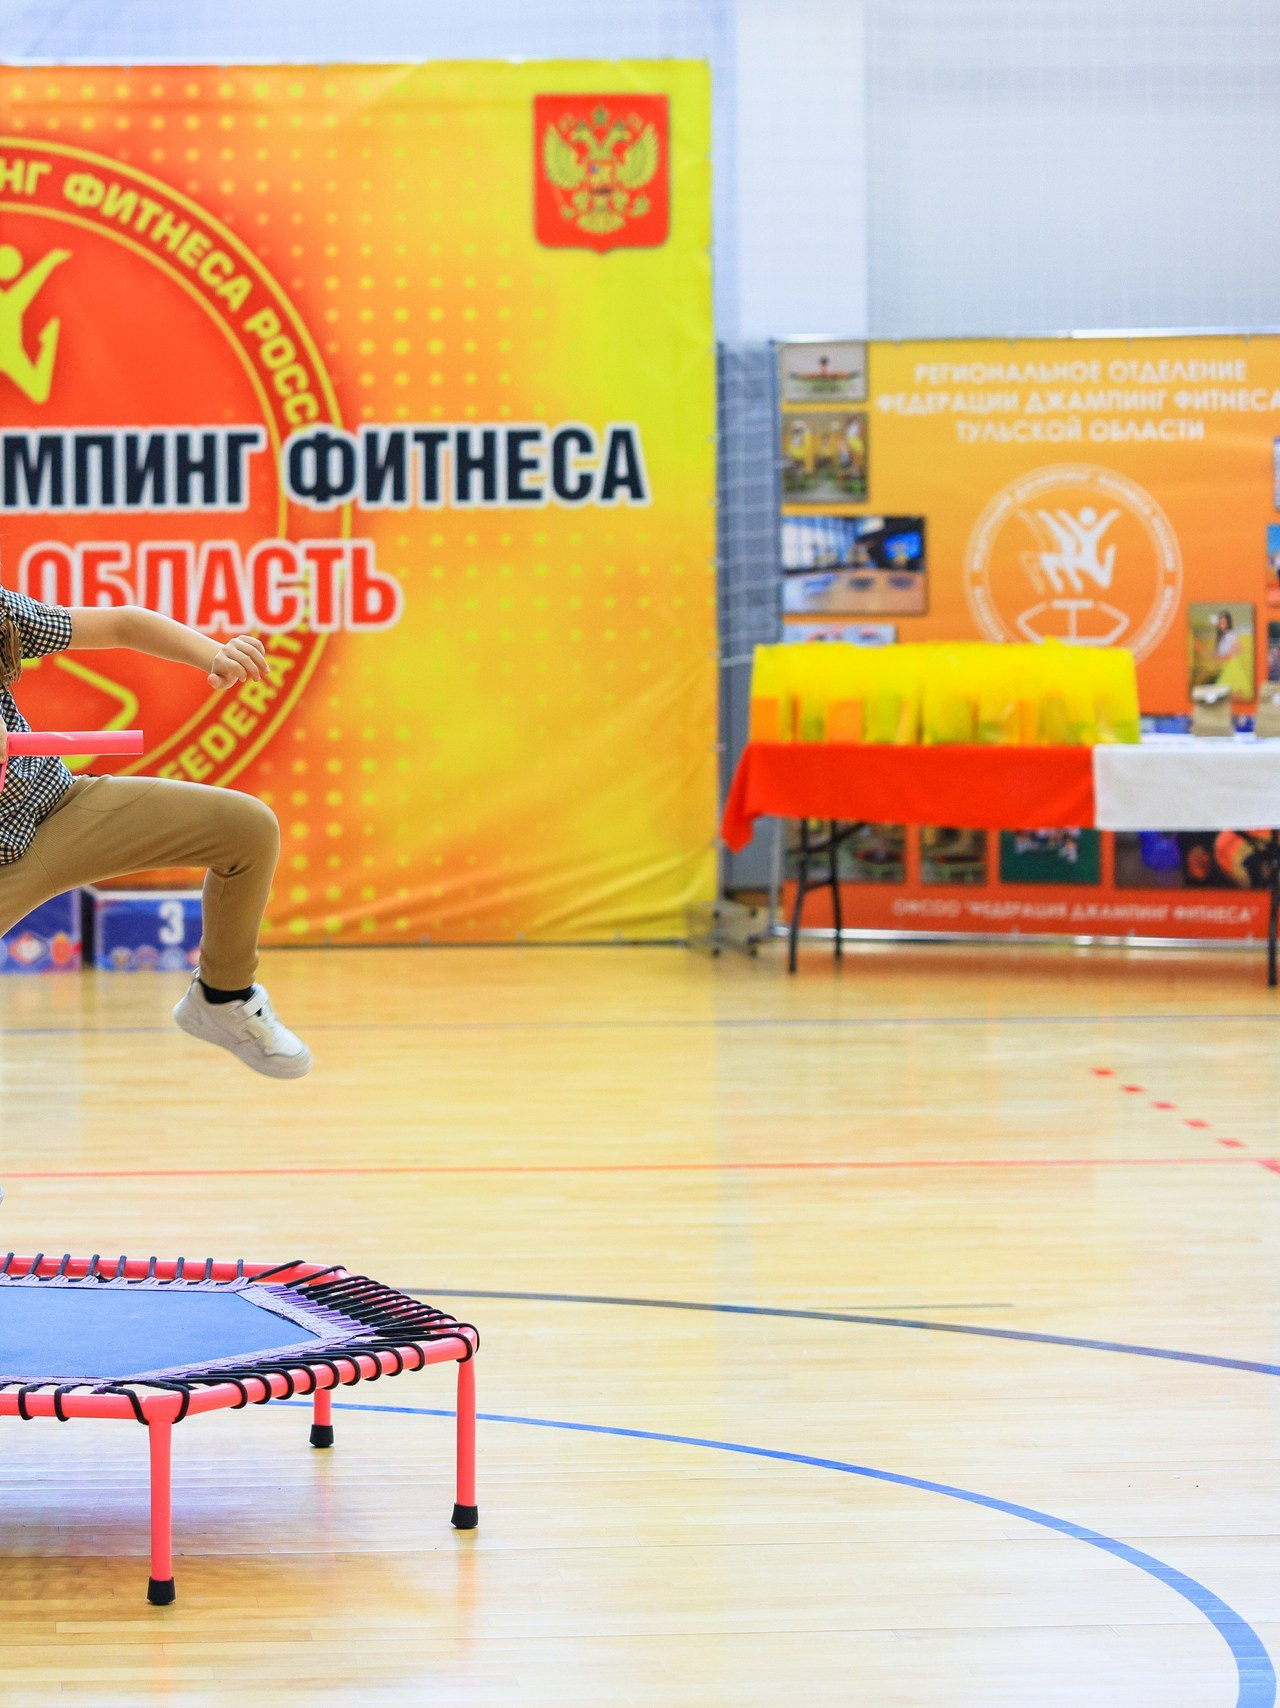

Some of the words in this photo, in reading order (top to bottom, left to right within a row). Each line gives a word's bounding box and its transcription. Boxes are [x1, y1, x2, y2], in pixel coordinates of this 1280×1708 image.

[63, 172, 253, 313] ФИТНЕСА
[242, 306, 321, 434] РОСС
[914, 360, 1101, 385] РЕГИОНАЛЬНОЕ
[1108, 359, 1248, 384] ОТДЕЛЕНИЕ
[1024, 390, 1168, 414] ДЖАМПИНГ
[956, 416, 1082, 442] ТУЛЬСКОЙ
[1089, 418, 1205, 441] ОБЛАСТИ
[282, 421, 652, 509] ФИТНЕСА
[21, 538, 404, 634] ОБЛАСТЬ
[157, 629, 303, 783] FEDERAT
[159, 900, 185, 945] 3
